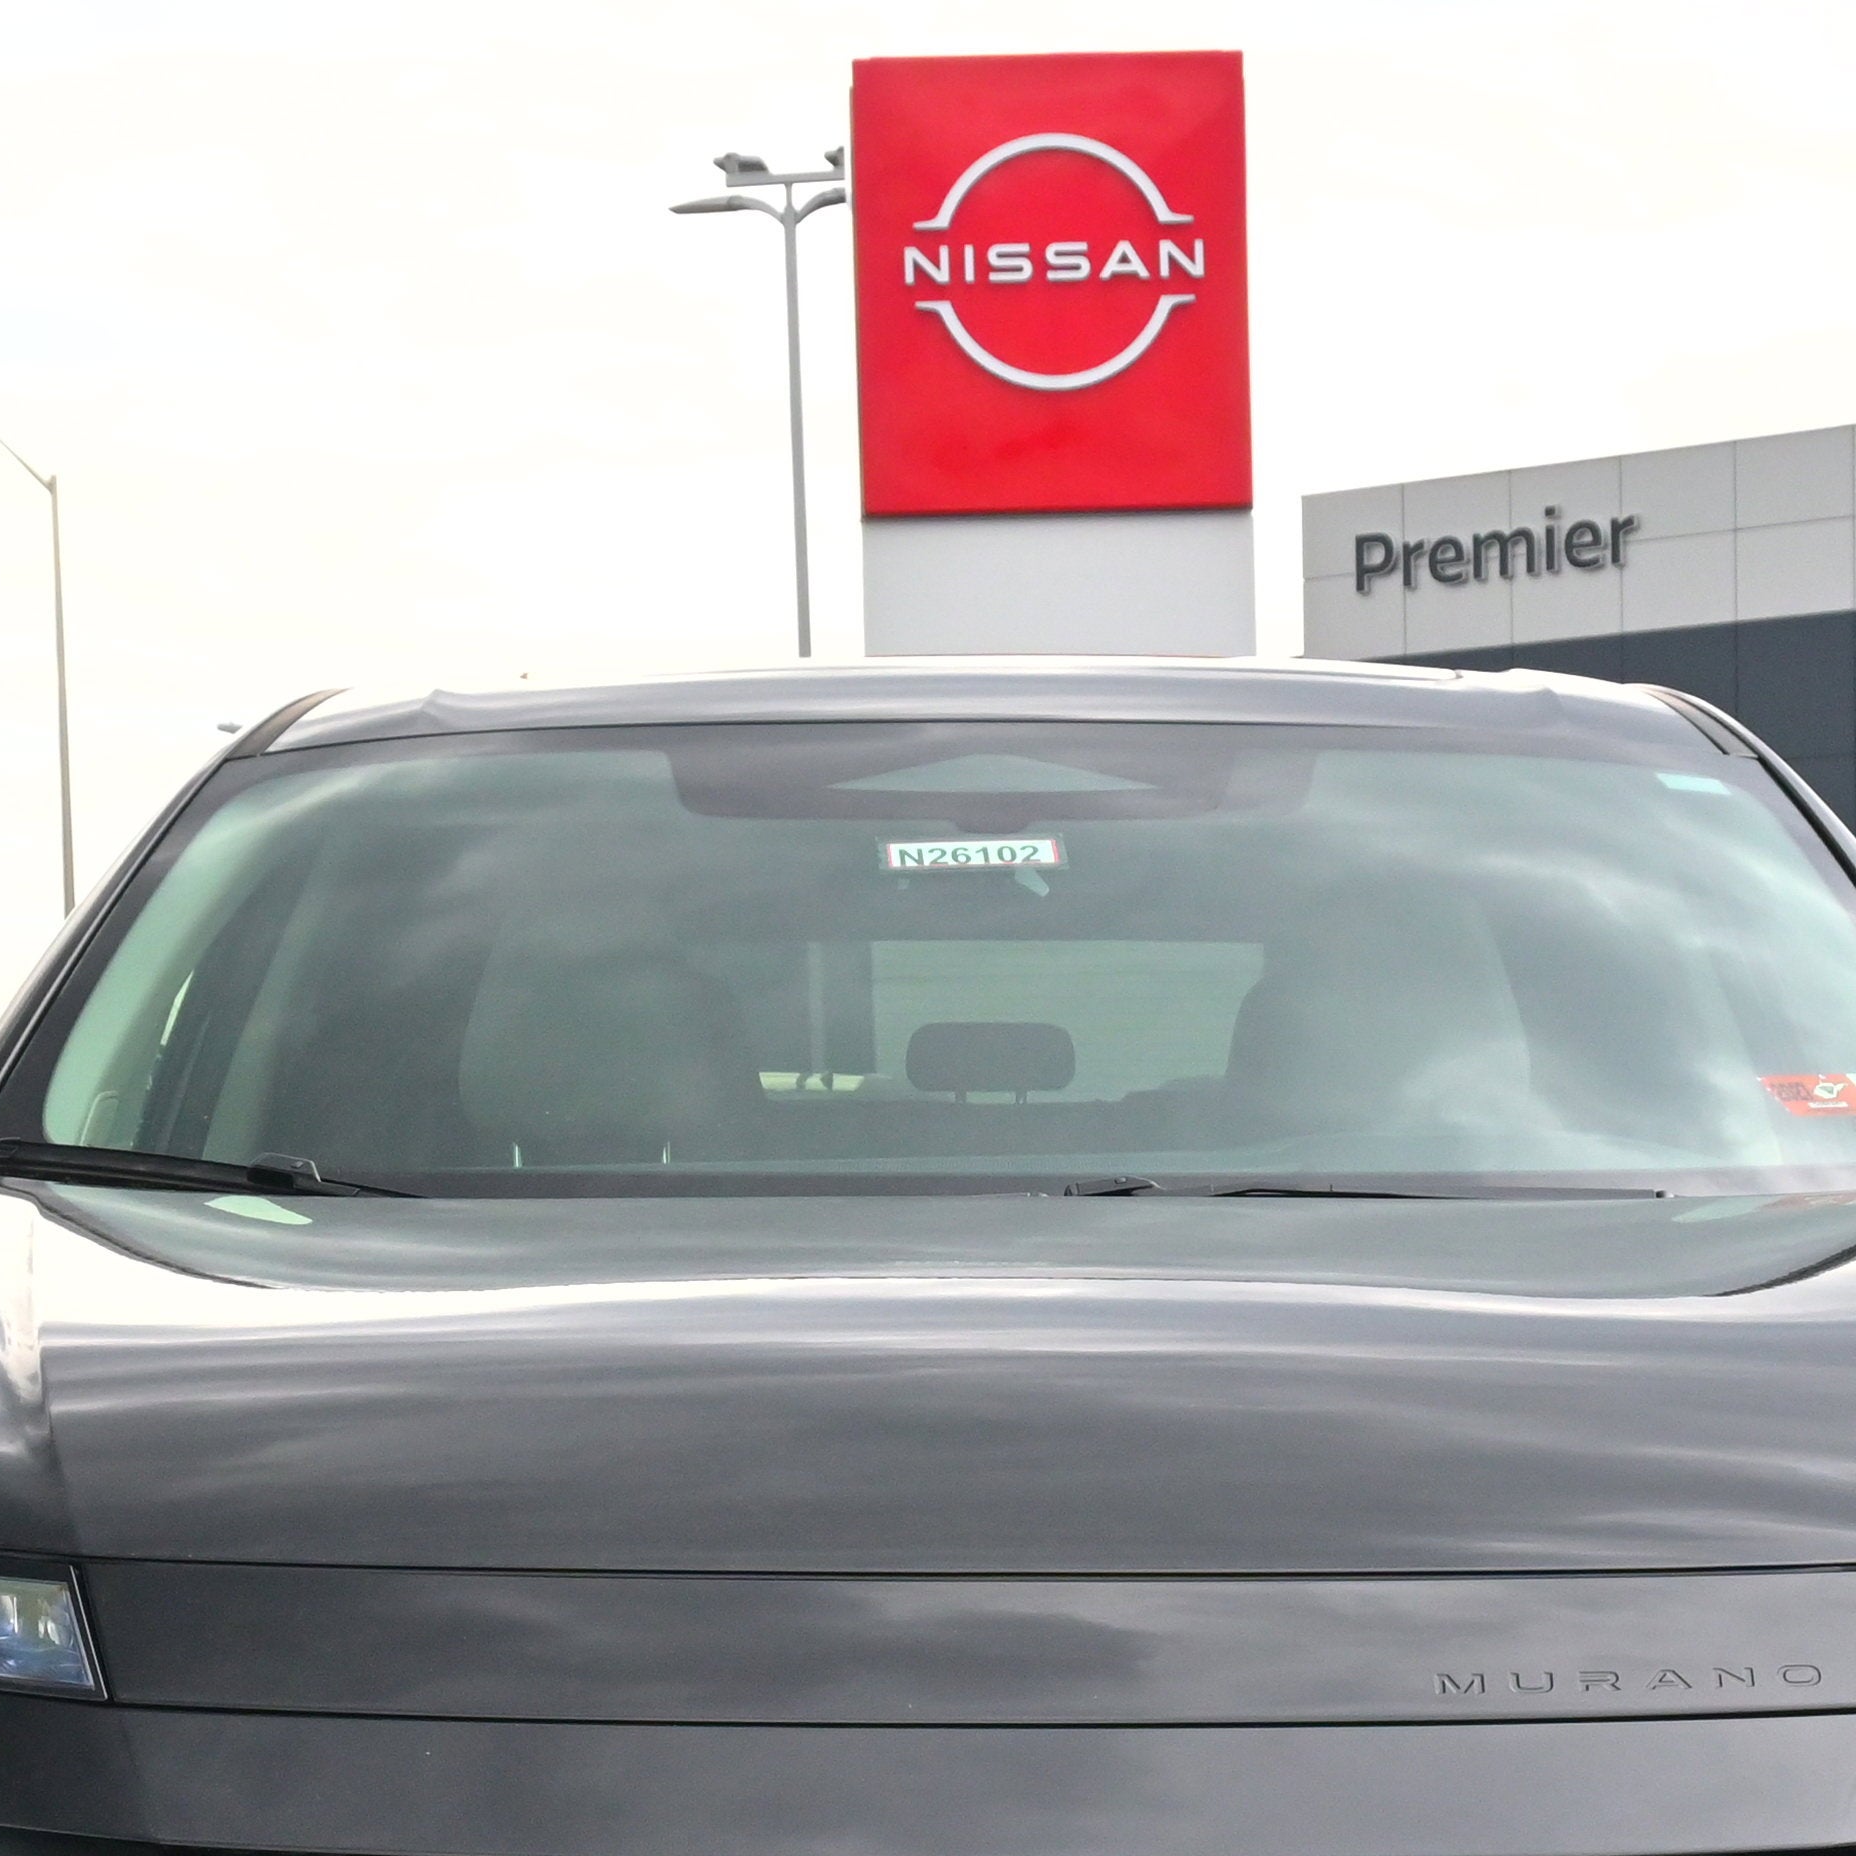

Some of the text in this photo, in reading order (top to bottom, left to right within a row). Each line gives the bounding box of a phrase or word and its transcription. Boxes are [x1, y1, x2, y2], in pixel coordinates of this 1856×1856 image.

[904, 239, 1204, 285] NISSAN
[1354, 504, 1639, 594] Premier
[898, 844, 1042, 867] N26102
[1434, 1664, 1823, 1696] MURANO
